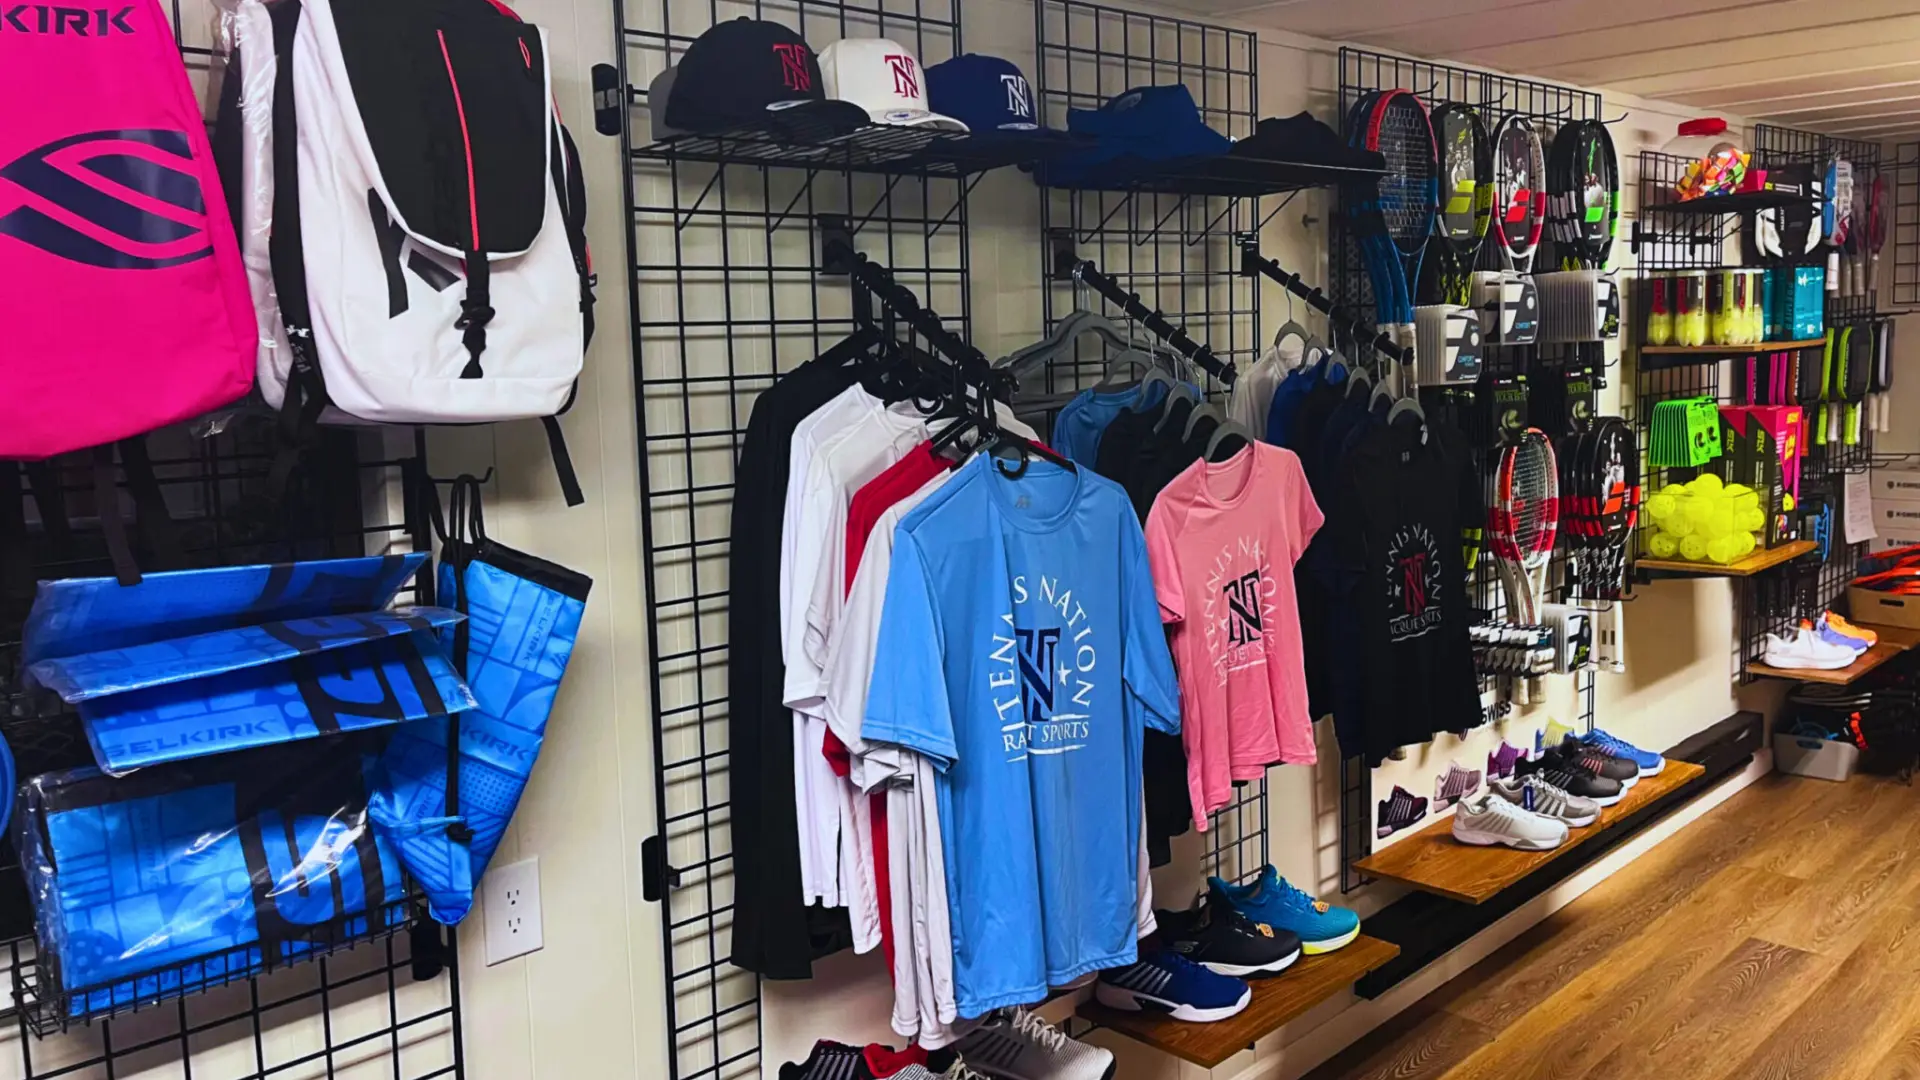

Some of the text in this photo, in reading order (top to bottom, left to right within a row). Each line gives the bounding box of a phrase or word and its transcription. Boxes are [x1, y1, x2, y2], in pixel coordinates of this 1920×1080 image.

[1038, 574, 1096, 707] NATION
[106, 721, 272, 758] SELKIRK
[1041, 721, 1090, 742] SPORTS
